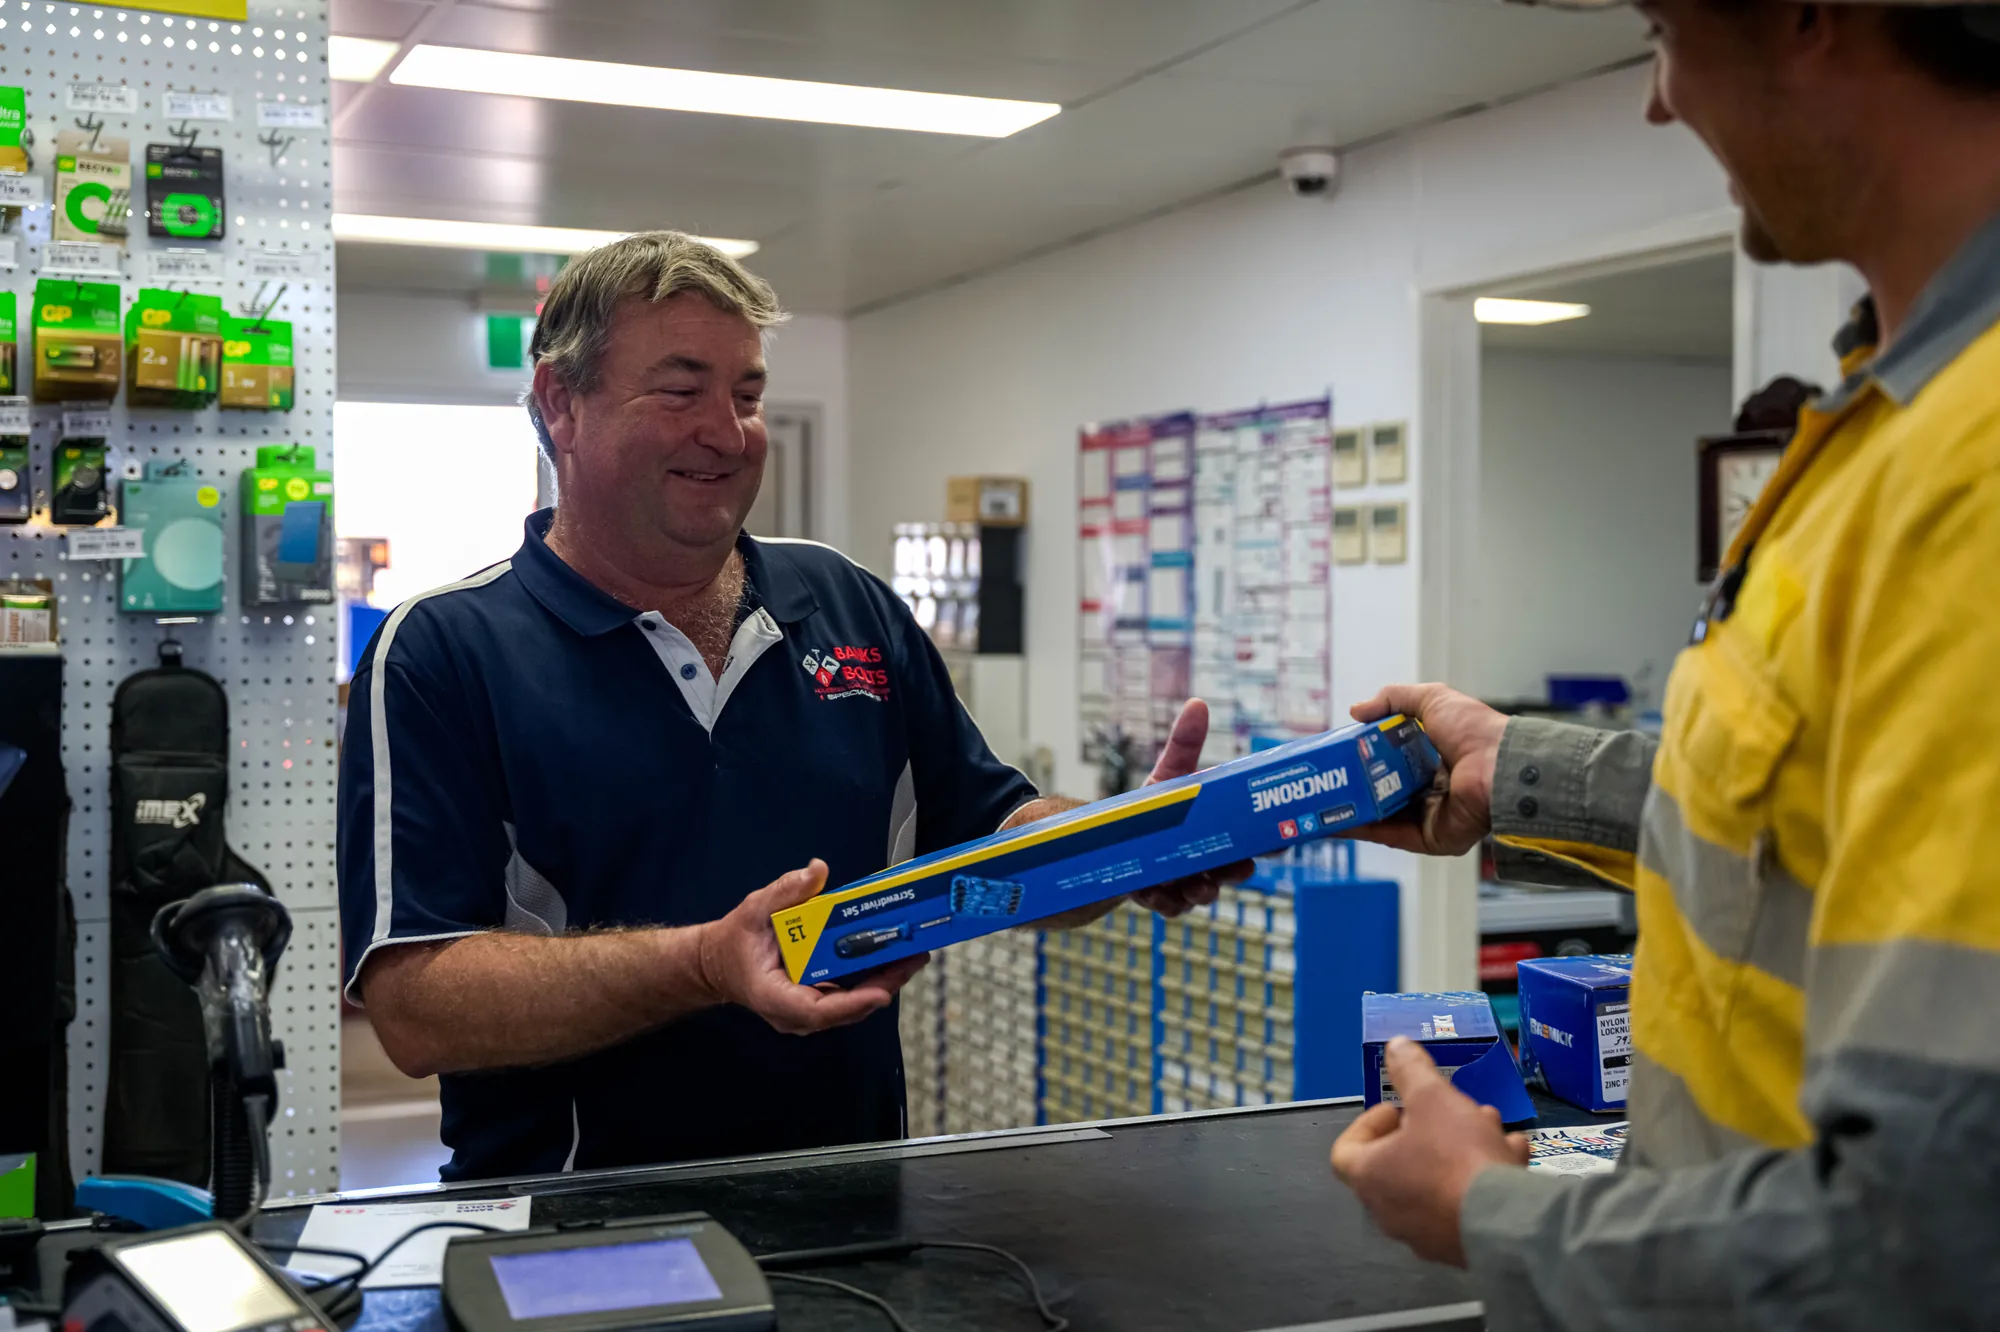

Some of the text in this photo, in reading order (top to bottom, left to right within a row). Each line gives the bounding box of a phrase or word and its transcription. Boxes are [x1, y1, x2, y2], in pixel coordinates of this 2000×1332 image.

[41, 304, 73, 323] GP
[1251, 766, 1349, 813] KINCROME
[842, 889, 915, 918] Screwdriver Set
[785, 916, 802, 926] piece
[788, 925, 806, 942] 13
[1600, 1017, 1625, 1028] NYLON
[1600, 1025, 1632, 1036] LOCKNU
[1529, 1017, 1574, 1048] BREMICK
[1604, 1080, 1621, 1090] ZINC
